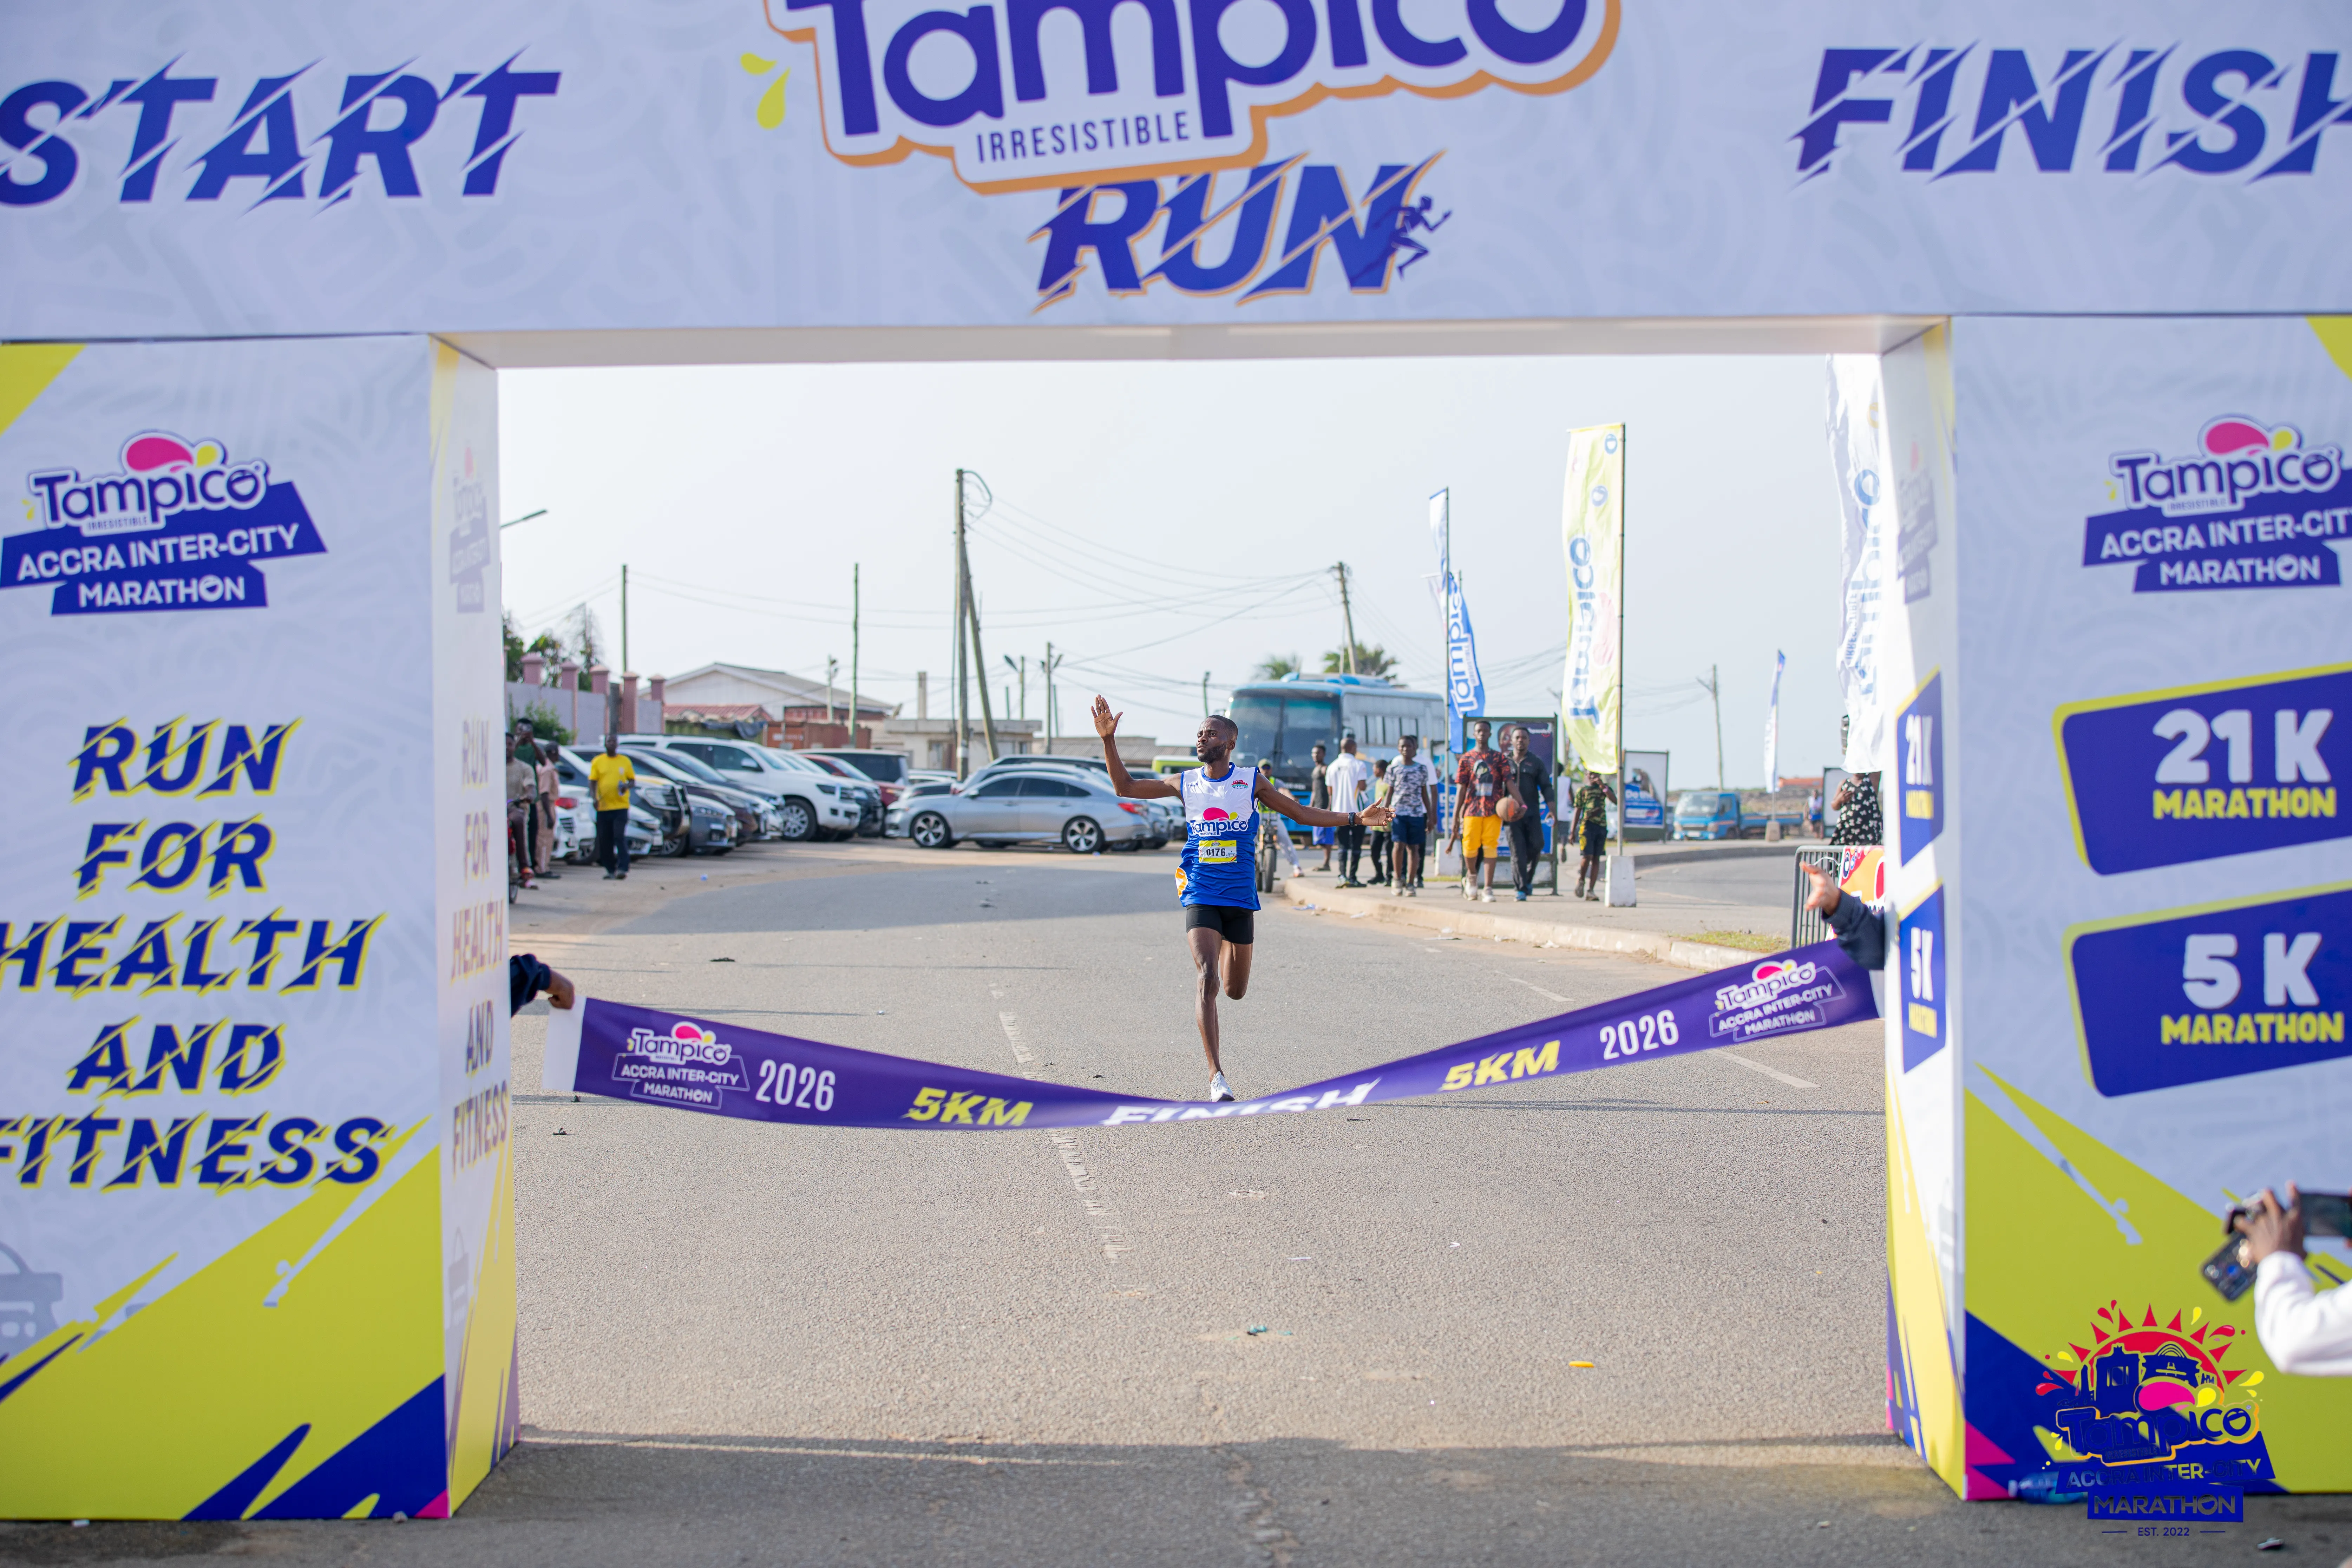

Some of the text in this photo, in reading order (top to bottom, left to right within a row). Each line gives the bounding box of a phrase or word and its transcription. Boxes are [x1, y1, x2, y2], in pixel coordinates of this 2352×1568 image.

[0, 44, 563, 217] START
[977, 111, 1189, 163] IRRESISTIBLE
[1029, 152, 1445, 314] RUN
[33, 469, 260, 524] Tampico
[2117, 453, 2333, 505] Tampico
[2167, 497, 2227, 512] IRRESISTIBLE
[87, 516, 148, 531] IRRESISTIBLE
[2101, 507, 2352, 559] ACCRA INTER-CIT
[17, 523, 300, 582] ACCRA INTER-CITY
[2160, 554, 2321, 586] MARATHON
[78, 575, 245, 608] MARATHON
[68, 716, 302, 801] RUN
[462, 718, 490, 788] RUN
[1190, 820, 1247, 835] Tampico
[2153, 787, 2337, 819] MARATHON
[72, 813, 274, 900] FOR
[464, 808, 490, 884] FOR
[1206, 848, 1226, 857] 0176
[0, 907, 387, 997] HEALTH
[451, 896, 504, 984] HEALTH
[1719, 983, 1833, 1031] ACCRA INTER-CITY
[1721, 969, 1812, 1009] Tampico
[466, 999, 494, 1076] AND
[1599, 1009, 1679, 1060] 2026
[1744, 1009, 1815, 1035] MARATHON
[2161, 1011, 2344, 1044] MARATHON
[66, 1016, 285, 1100] AND
[635, 1032, 727, 1064] Tampico
[1439, 1040, 1560, 1090] 5KM
[621, 1064, 740, 1085] ACCRA INTER-CITY
[643, 1081, 713, 1104] MARATHON
[755, 1058, 837, 1112] 2026
[452, 1079, 508, 1175] FITNESS
[900, 1087, 1034, 1126] 5KM
